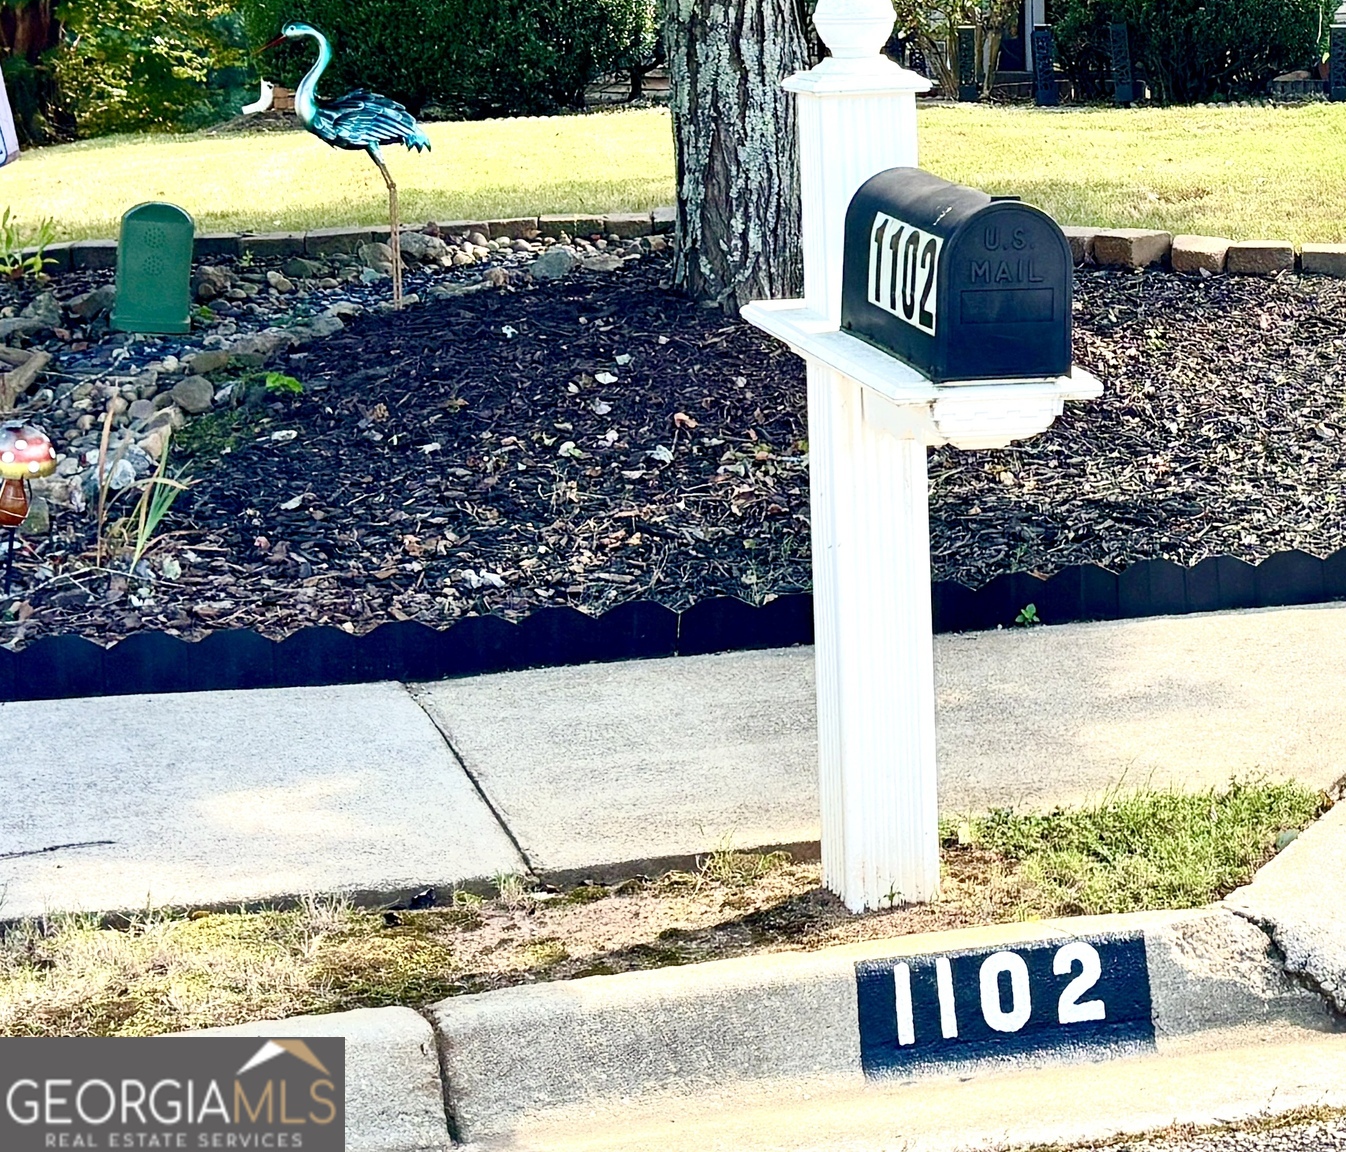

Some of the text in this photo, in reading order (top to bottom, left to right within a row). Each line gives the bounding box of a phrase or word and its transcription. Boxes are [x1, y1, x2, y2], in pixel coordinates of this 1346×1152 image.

[983, 227, 1035, 251] U.S.
[873, 218, 937, 330] 1102
[970, 260, 1044, 283] MAIL
[893, 942, 1106, 1046] 1102
